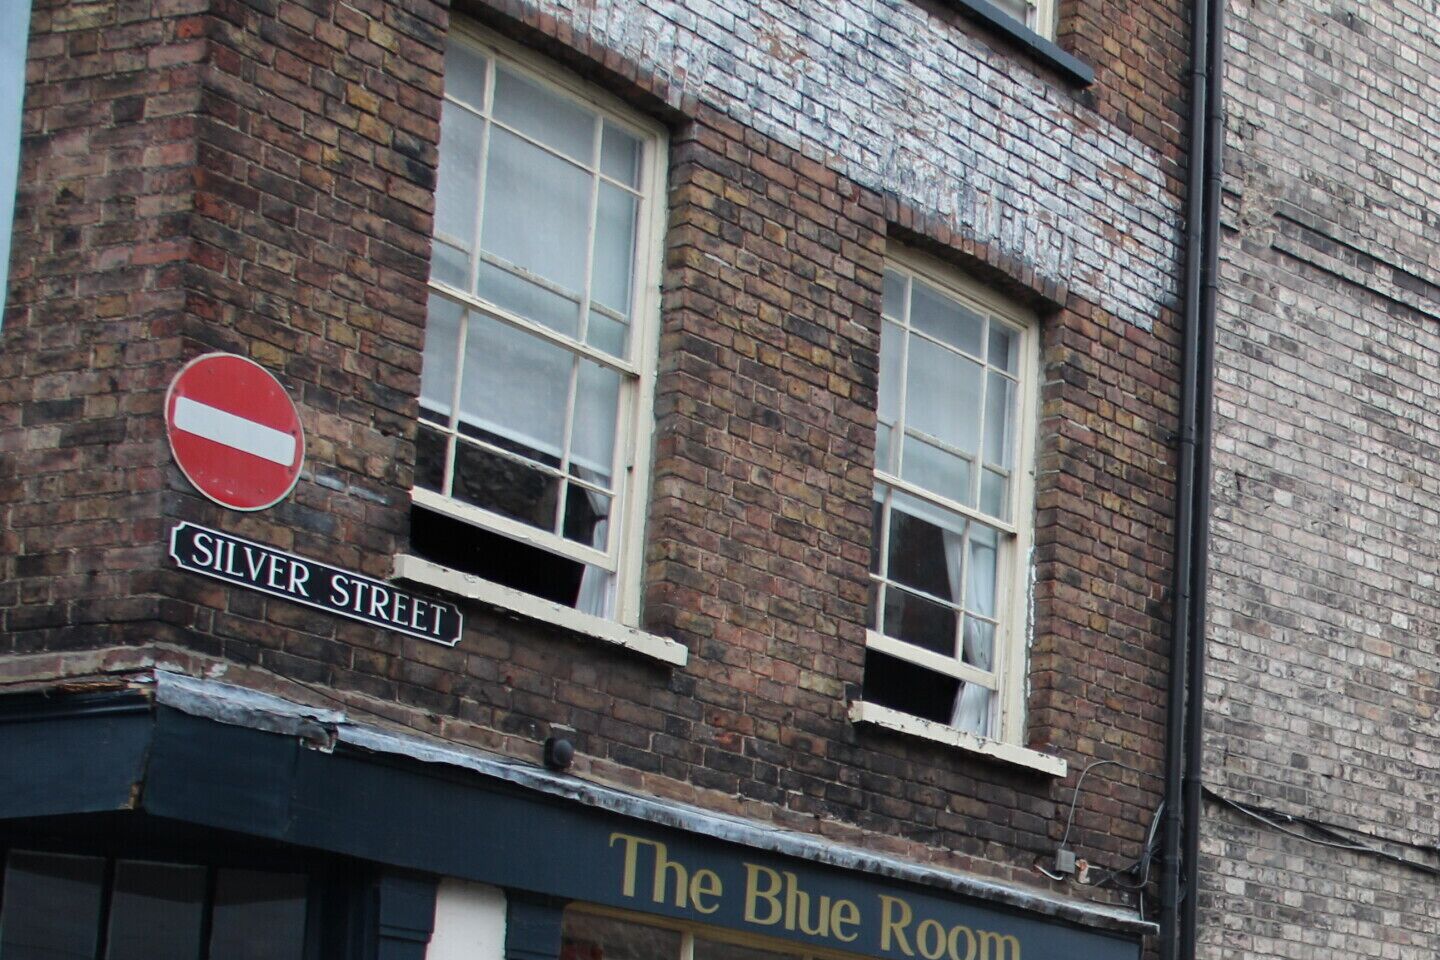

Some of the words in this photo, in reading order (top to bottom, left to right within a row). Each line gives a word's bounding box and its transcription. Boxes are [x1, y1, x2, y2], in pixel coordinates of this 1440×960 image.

[192, 532, 310, 598] SILVER
[329, 574, 447, 636] STREET
[609, 832, 723, 915] The
[742, 862, 861, 943] Blue
